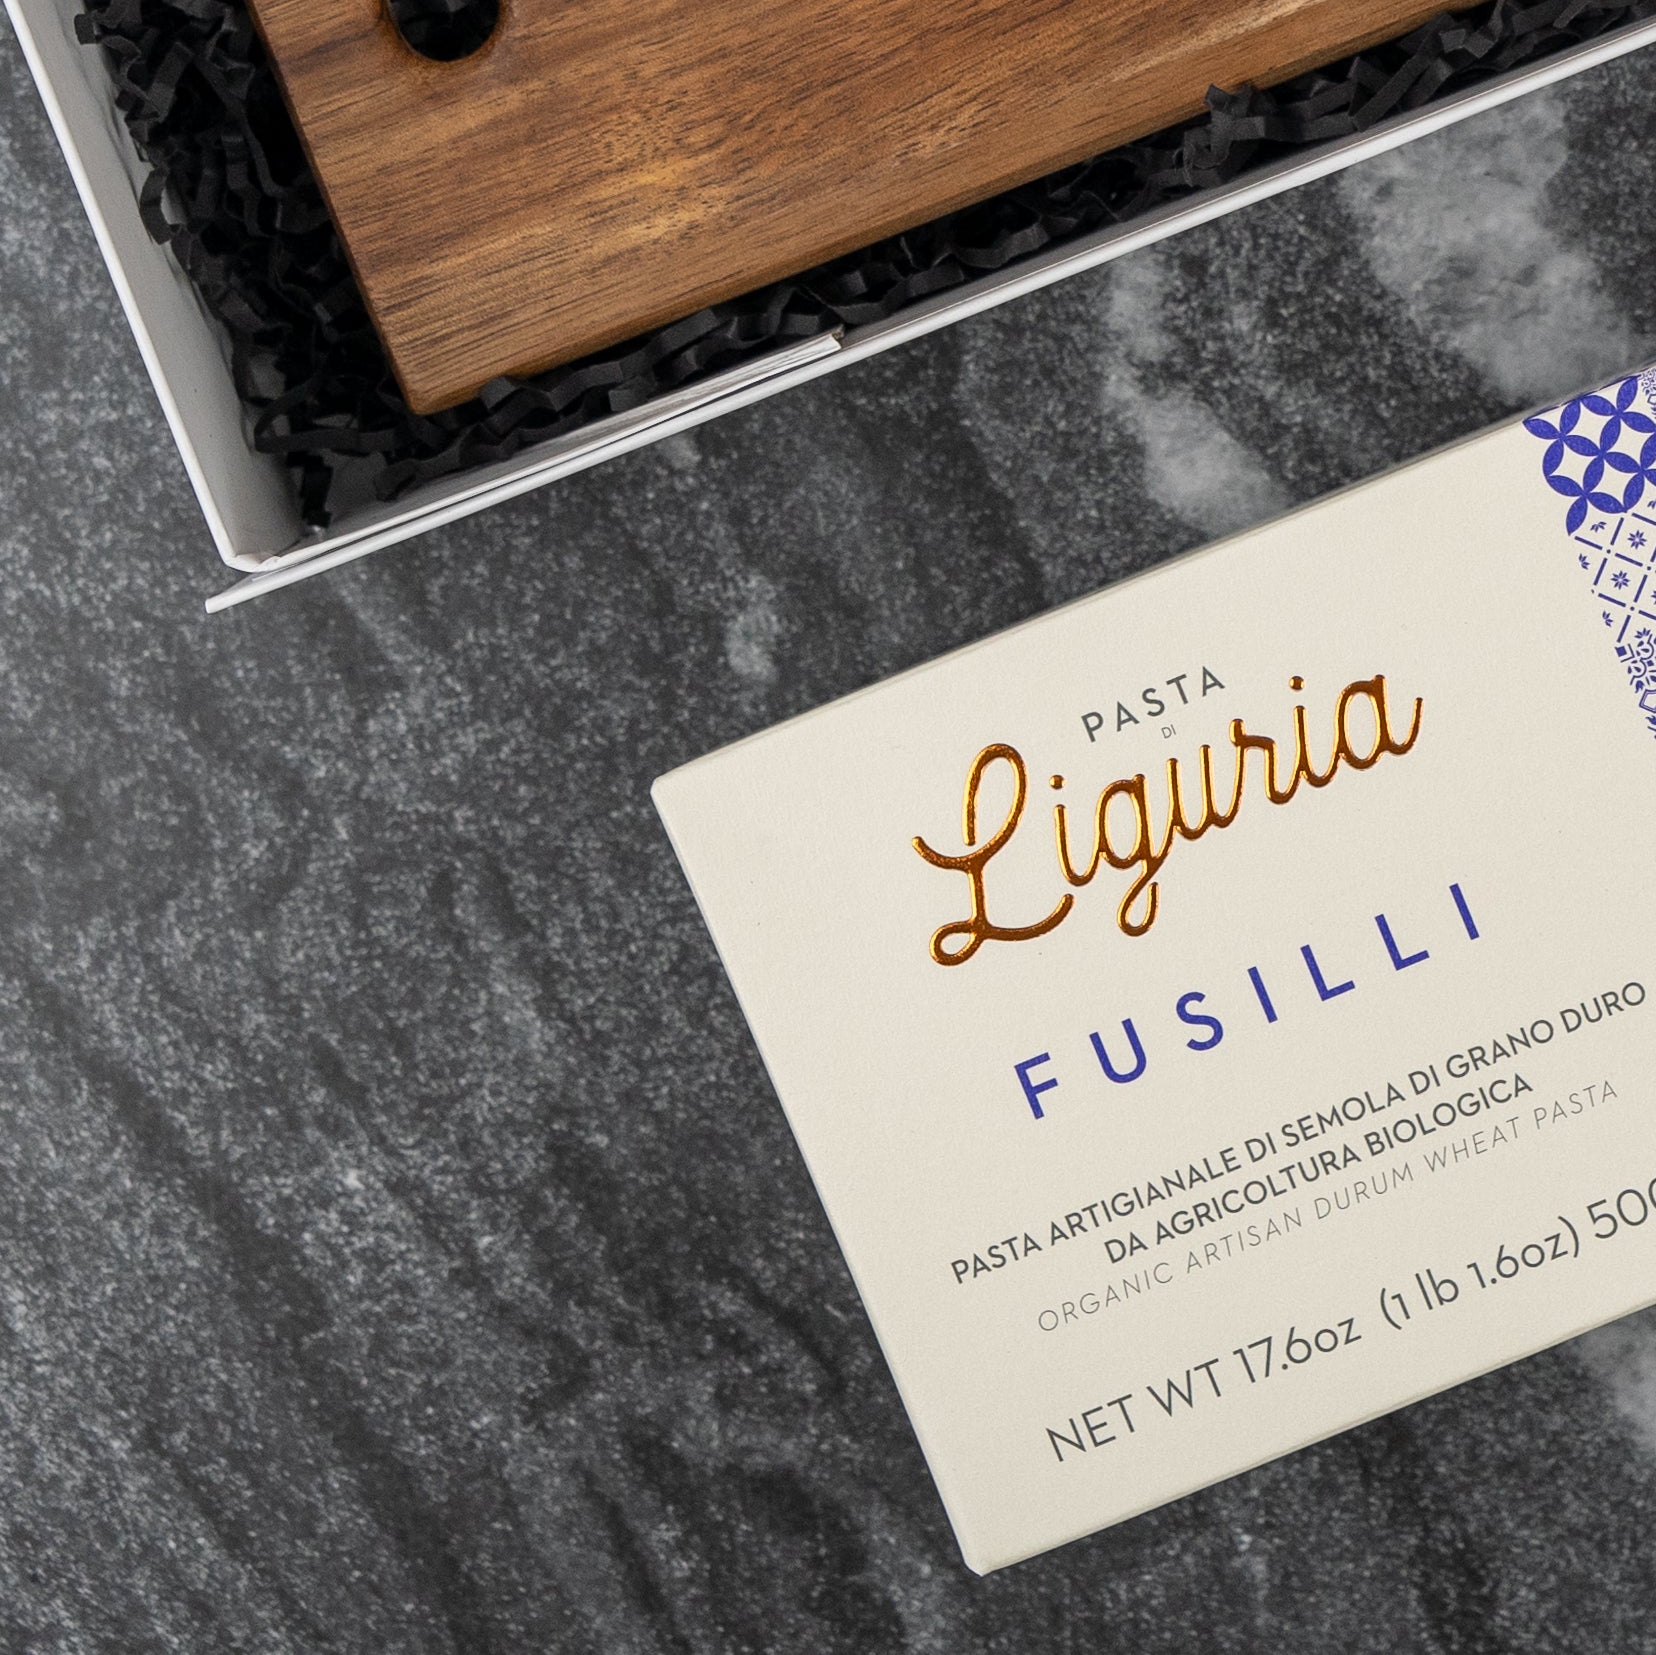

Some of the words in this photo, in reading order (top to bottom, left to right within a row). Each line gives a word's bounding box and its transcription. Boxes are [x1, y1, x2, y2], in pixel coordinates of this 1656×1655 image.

[911, 674, 1424, 967] Liguria
[1080, 665, 1226, 743] PASTA
[1160, 723, 1178, 740] DI
[1013, 882, 1482, 1120] FUSILLI
[950, 1232, 1043, 1284] PASTA
[1050, 1146, 1242, 1246] ARTIGIANALE
[1244, 1131, 1278, 1163] DI
[1281, 1082, 1406, 1148] SEMOLA
[1408, 1064, 1441, 1096] DI
[1445, 1019, 1554, 1079] GRANO
[1559, 981, 1646, 1033] DURO
[1038, 1262, 1174, 1331] ORGANIC
[1186, 1207, 1302, 1273] ARTISAN
[1314, 1162, 1414, 1220] DURUM
[1423, 1116, 1520, 1173] WHEAT
[1533, 1080, 1618, 1130] PASTA
[1104, 1231, 1149, 1264] DA
[1155, 1143, 1362, 1245] AGRICOLTURA
[1363, 1072, 1534, 1156] BIOLOGICA
[1044, 1394, 1140, 1463] NET
[1146, 1358, 1223, 1419] WT
[1232, 1314, 1363, 1385] 17.6oz
[1378, 1286, 1412, 1330] (1
[1415, 1270, 1460, 1311] lb
[1467, 1215, 1582, 1289] 1.6oz)
